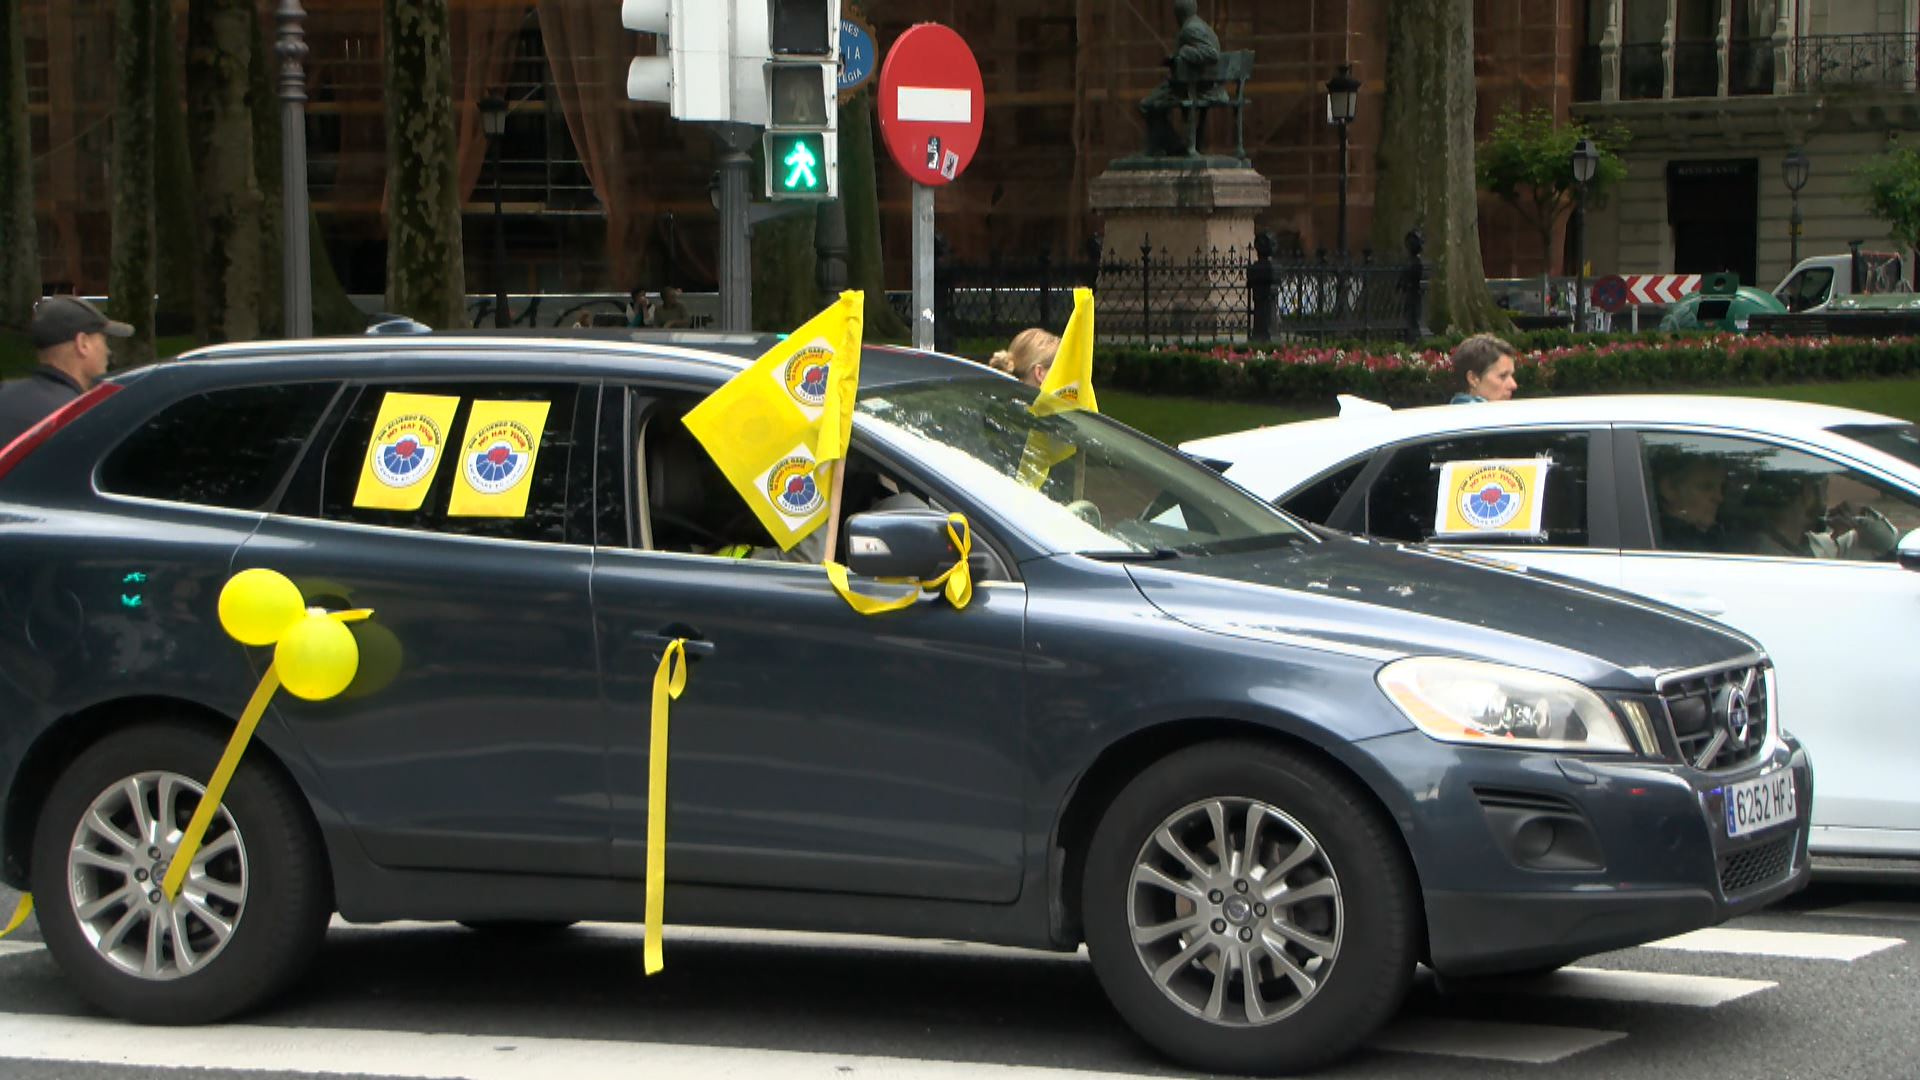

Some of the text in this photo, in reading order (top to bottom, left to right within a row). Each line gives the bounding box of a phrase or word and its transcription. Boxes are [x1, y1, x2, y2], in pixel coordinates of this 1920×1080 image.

[400, 422, 416, 431] HAY
[491, 429, 507, 437] HAY
[1481, 472, 1497, 480] HAY
[1736, 776, 1795, 827] 6252 HFJ
